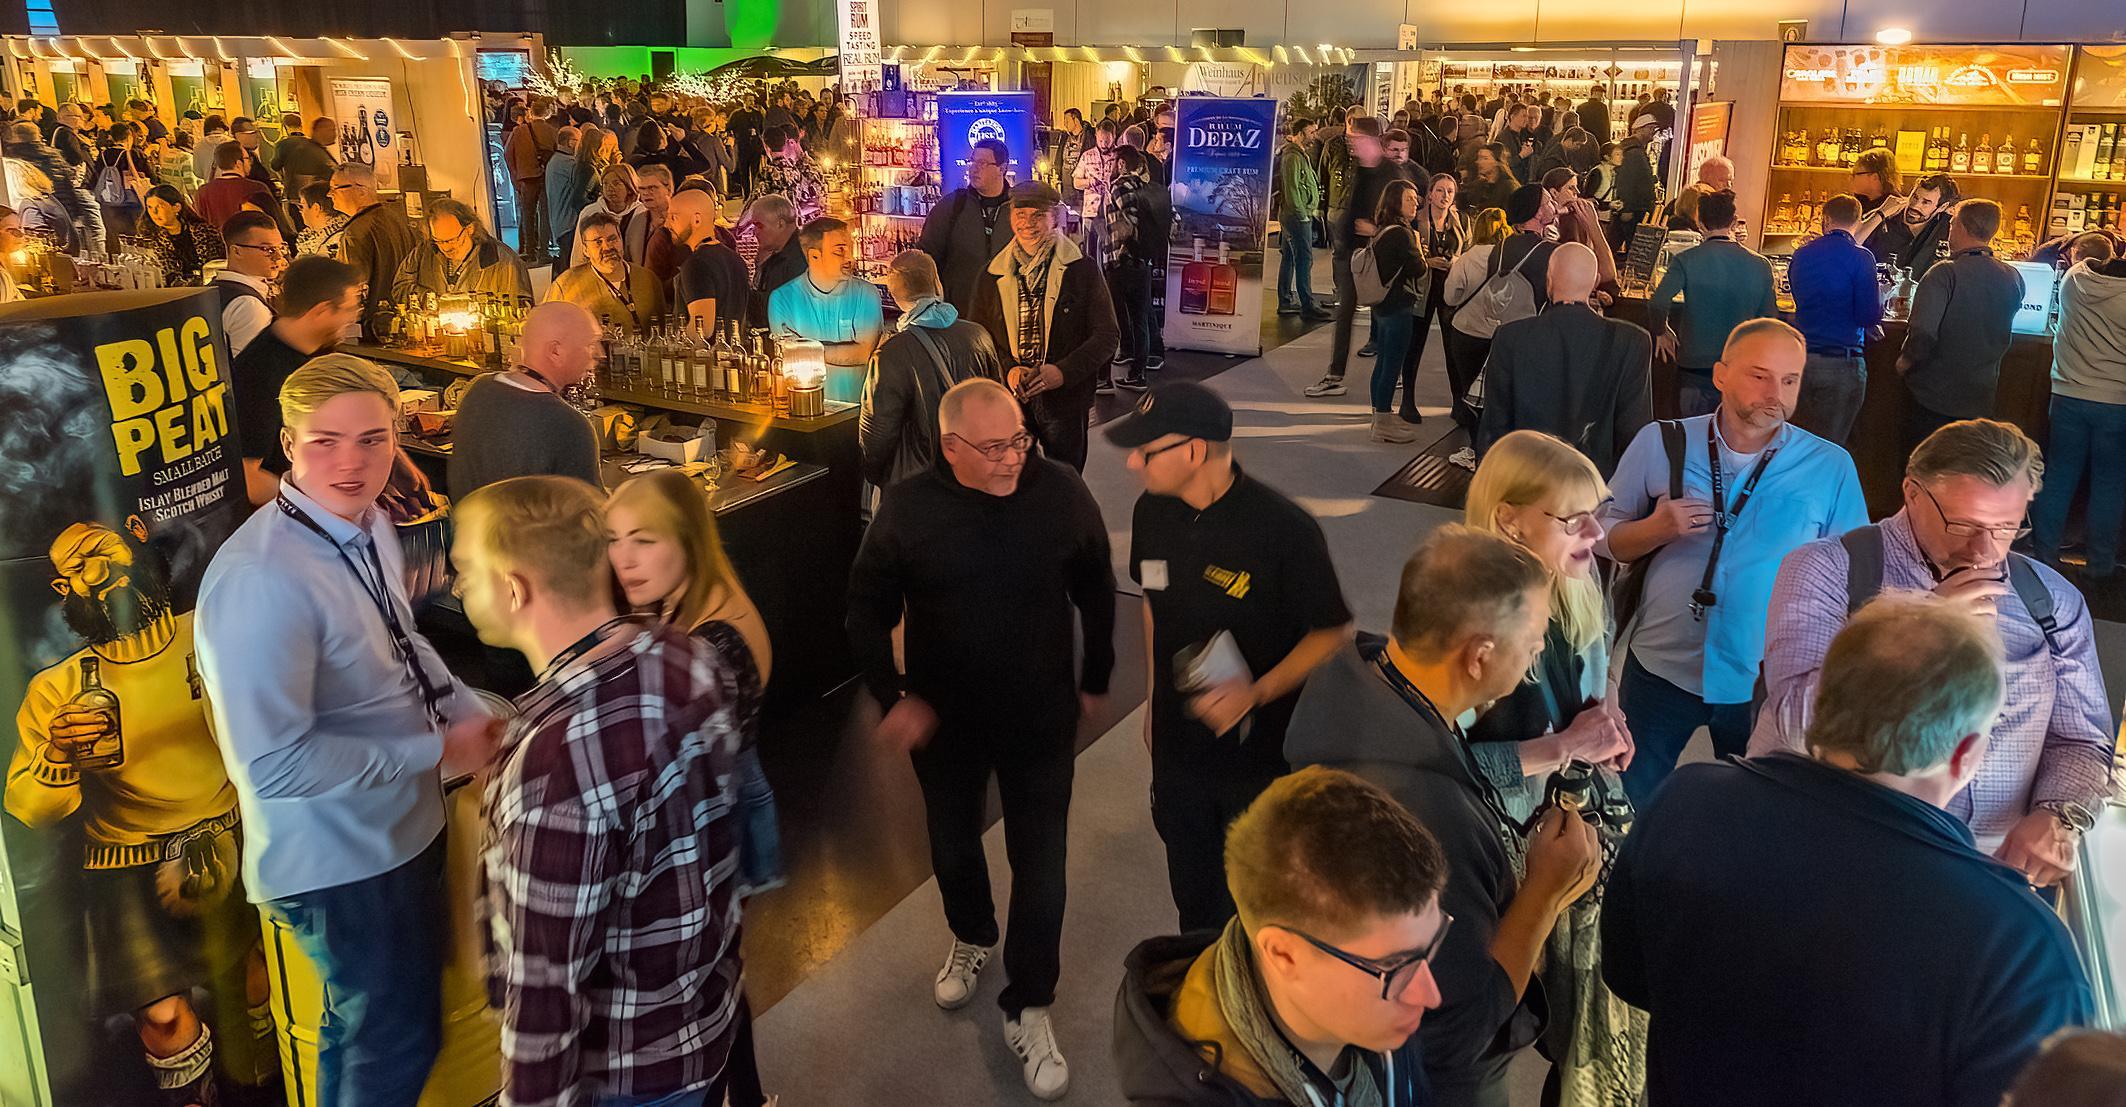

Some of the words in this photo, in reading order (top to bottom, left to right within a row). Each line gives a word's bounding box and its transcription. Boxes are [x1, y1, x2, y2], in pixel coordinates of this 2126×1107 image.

[850, 13, 868, 28] RUM
[849, 31, 871, 40] SPEED
[846, 41, 875, 50] TASTING
[843, 53, 861, 64] REAL
[864, 53, 881, 63] RUM
[1200, 63, 1245, 79] Weinhaus
[1188, 127, 1261, 149] DEPAZ
[1192, 321, 1232, 330] MARTINIQUE
[94, 315, 218, 423] BIG
[110, 381, 229, 477] PEAT
[153, 459, 195, 485] SMALL
[194, 445, 223, 470] BATCH
[138, 491, 171, 512] ISLAY
[173, 477, 212, 502] BLENDED
[211, 467, 229, 487] MALT
[155, 499, 195, 521] SCOTCH
[195, 485, 225, 509] WHISKY
